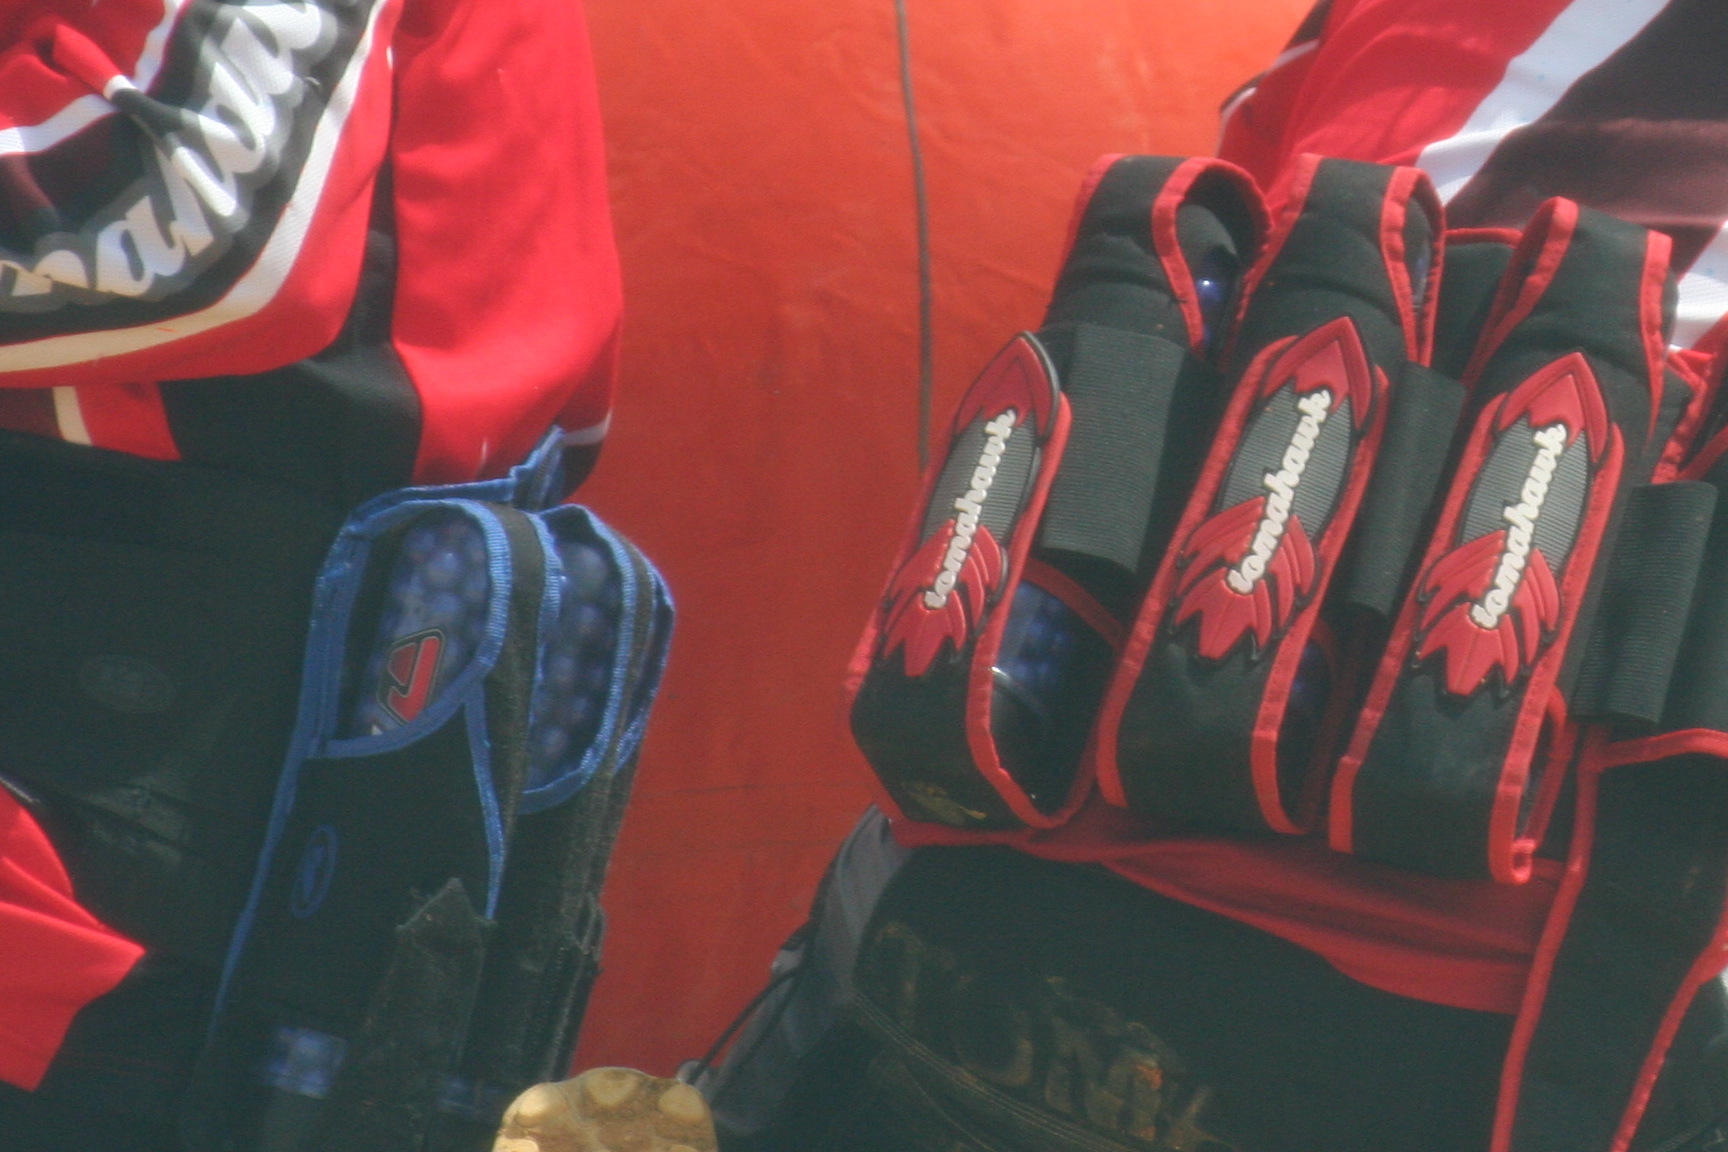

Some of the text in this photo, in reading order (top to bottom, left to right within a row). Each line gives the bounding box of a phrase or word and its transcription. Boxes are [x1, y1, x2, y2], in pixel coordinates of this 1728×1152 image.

[924, 408, 1017, 609] tomahawk
[1227, 389, 1332, 594] tomahawk
[1470, 423, 1567, 629] tomahawk
